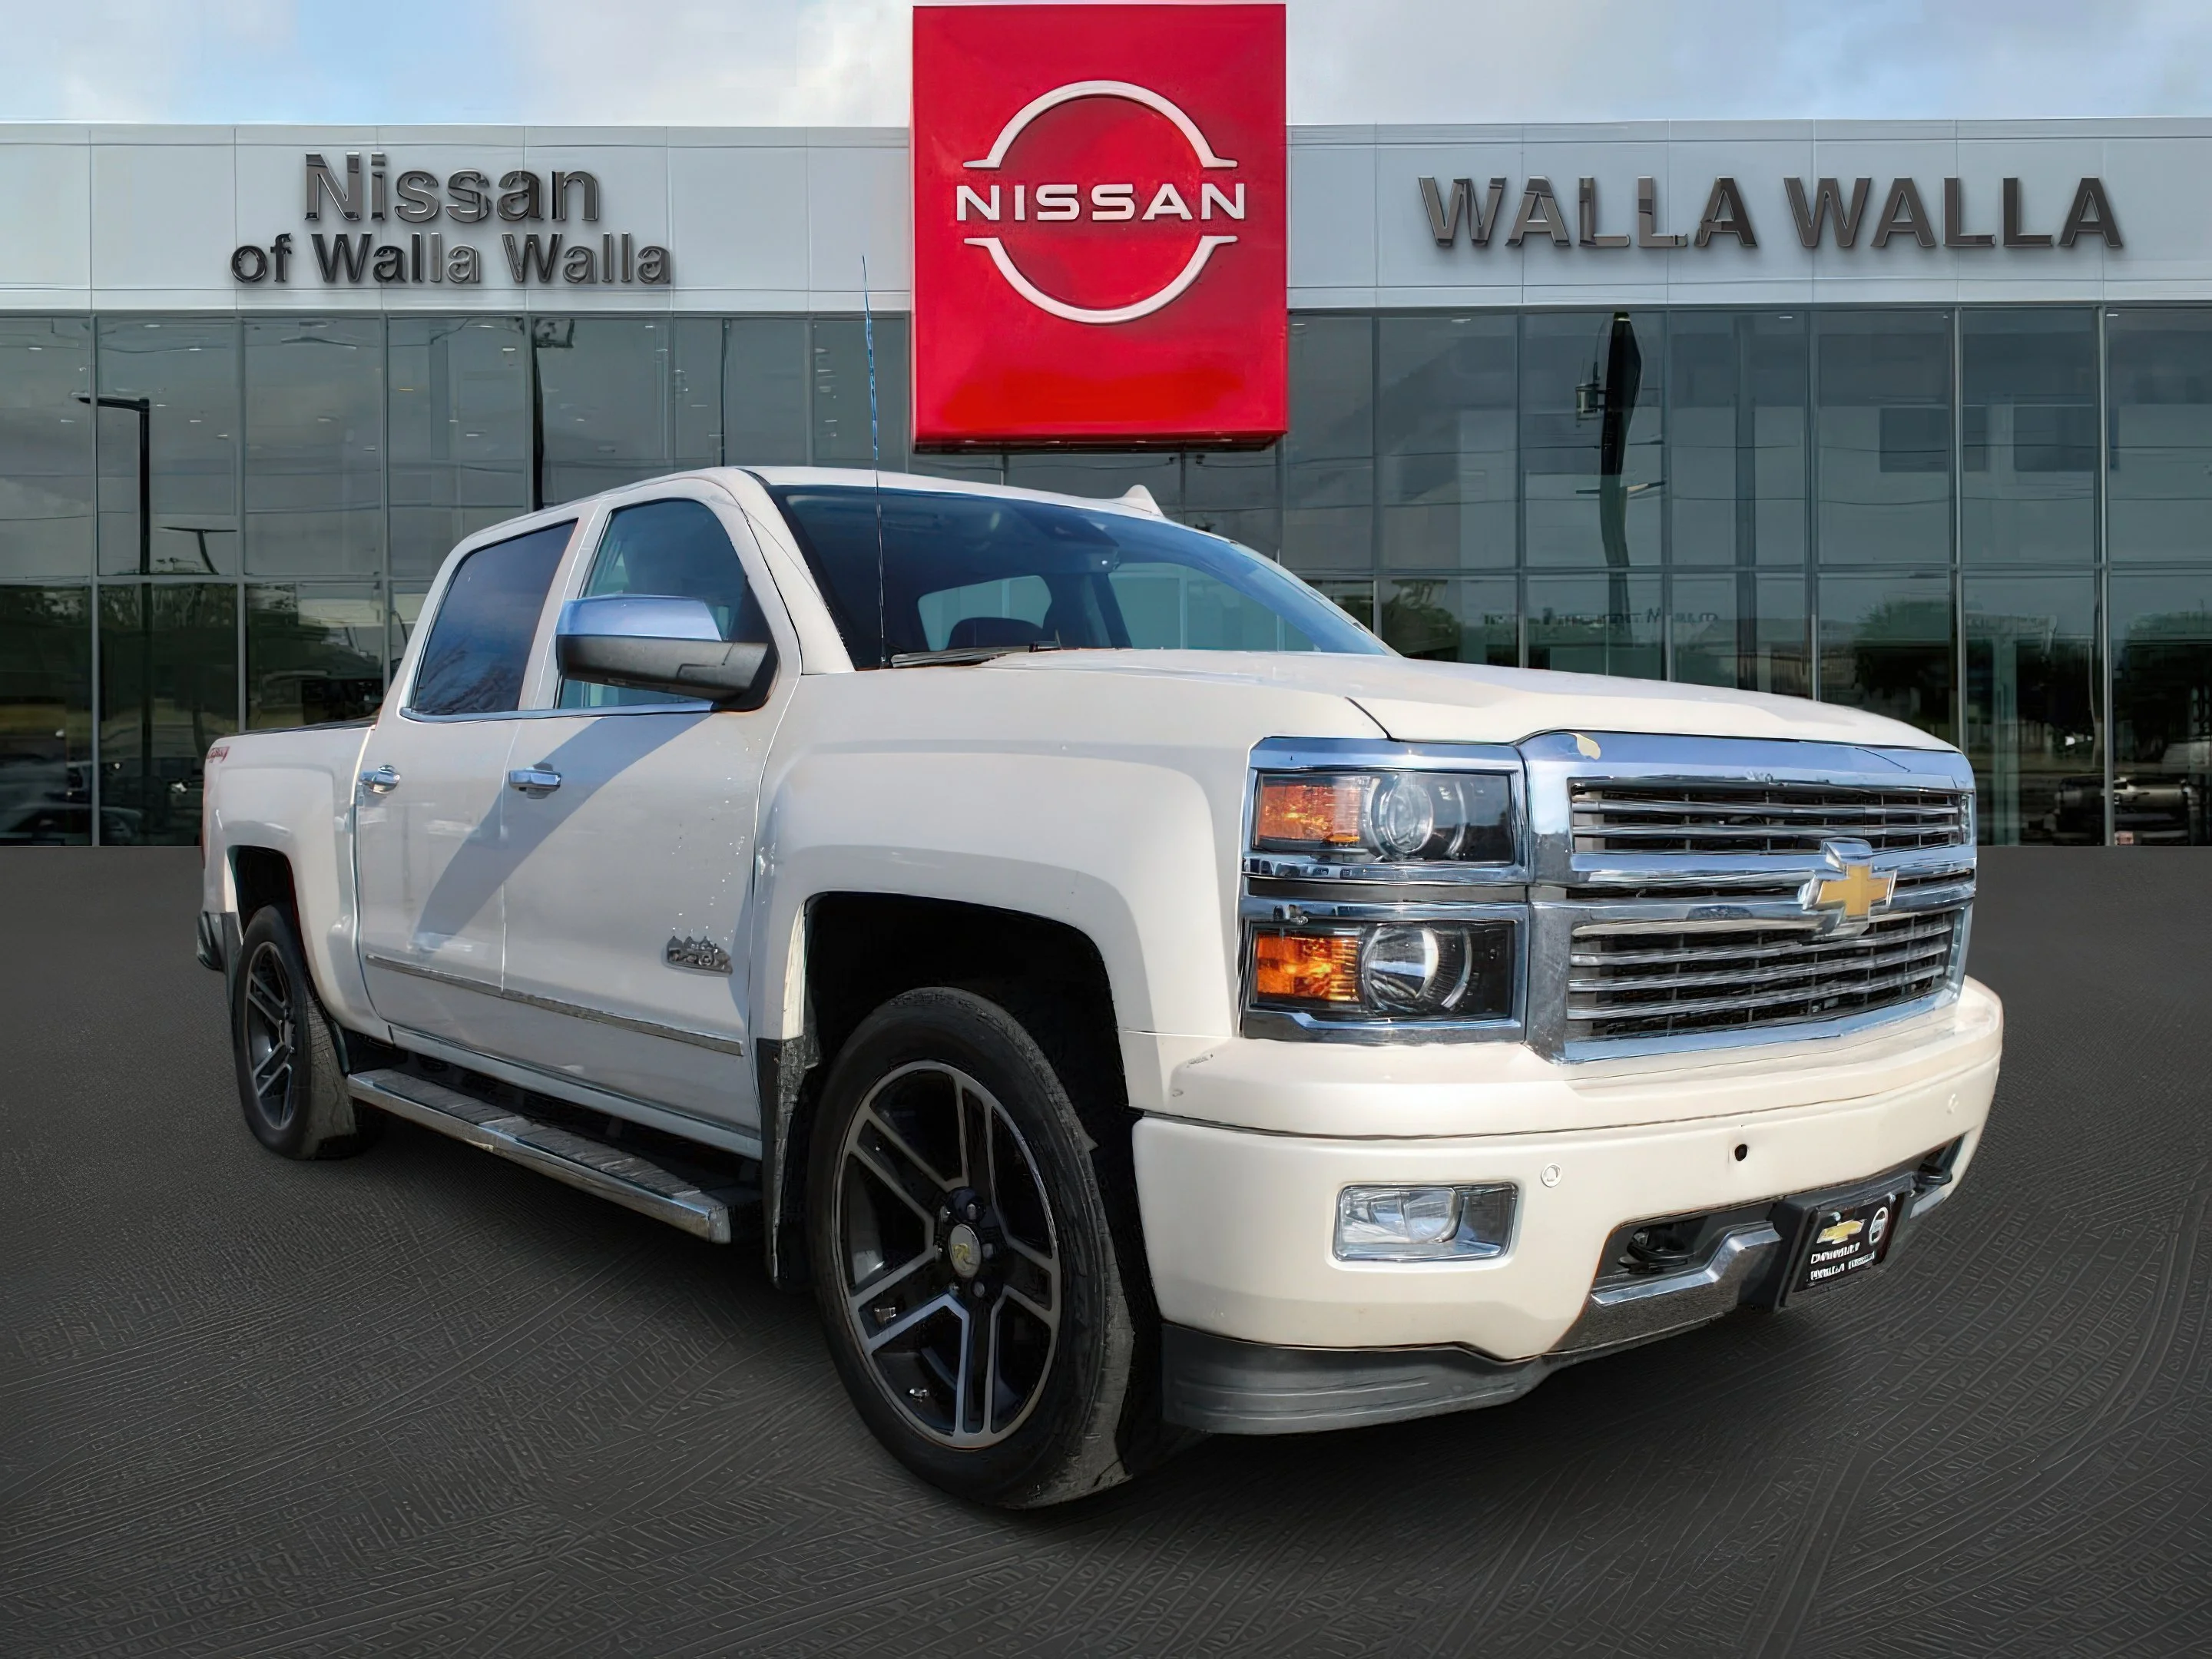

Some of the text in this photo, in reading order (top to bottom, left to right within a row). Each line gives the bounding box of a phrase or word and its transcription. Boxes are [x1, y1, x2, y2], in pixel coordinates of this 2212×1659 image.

[305, 151, 599, 223] Nissan
[956, 183, 1245, 221] NISSAN
[1418, 175, 2123, 248] WALLA WALLA
[230, 233, 672, 283] of Walla Walla
